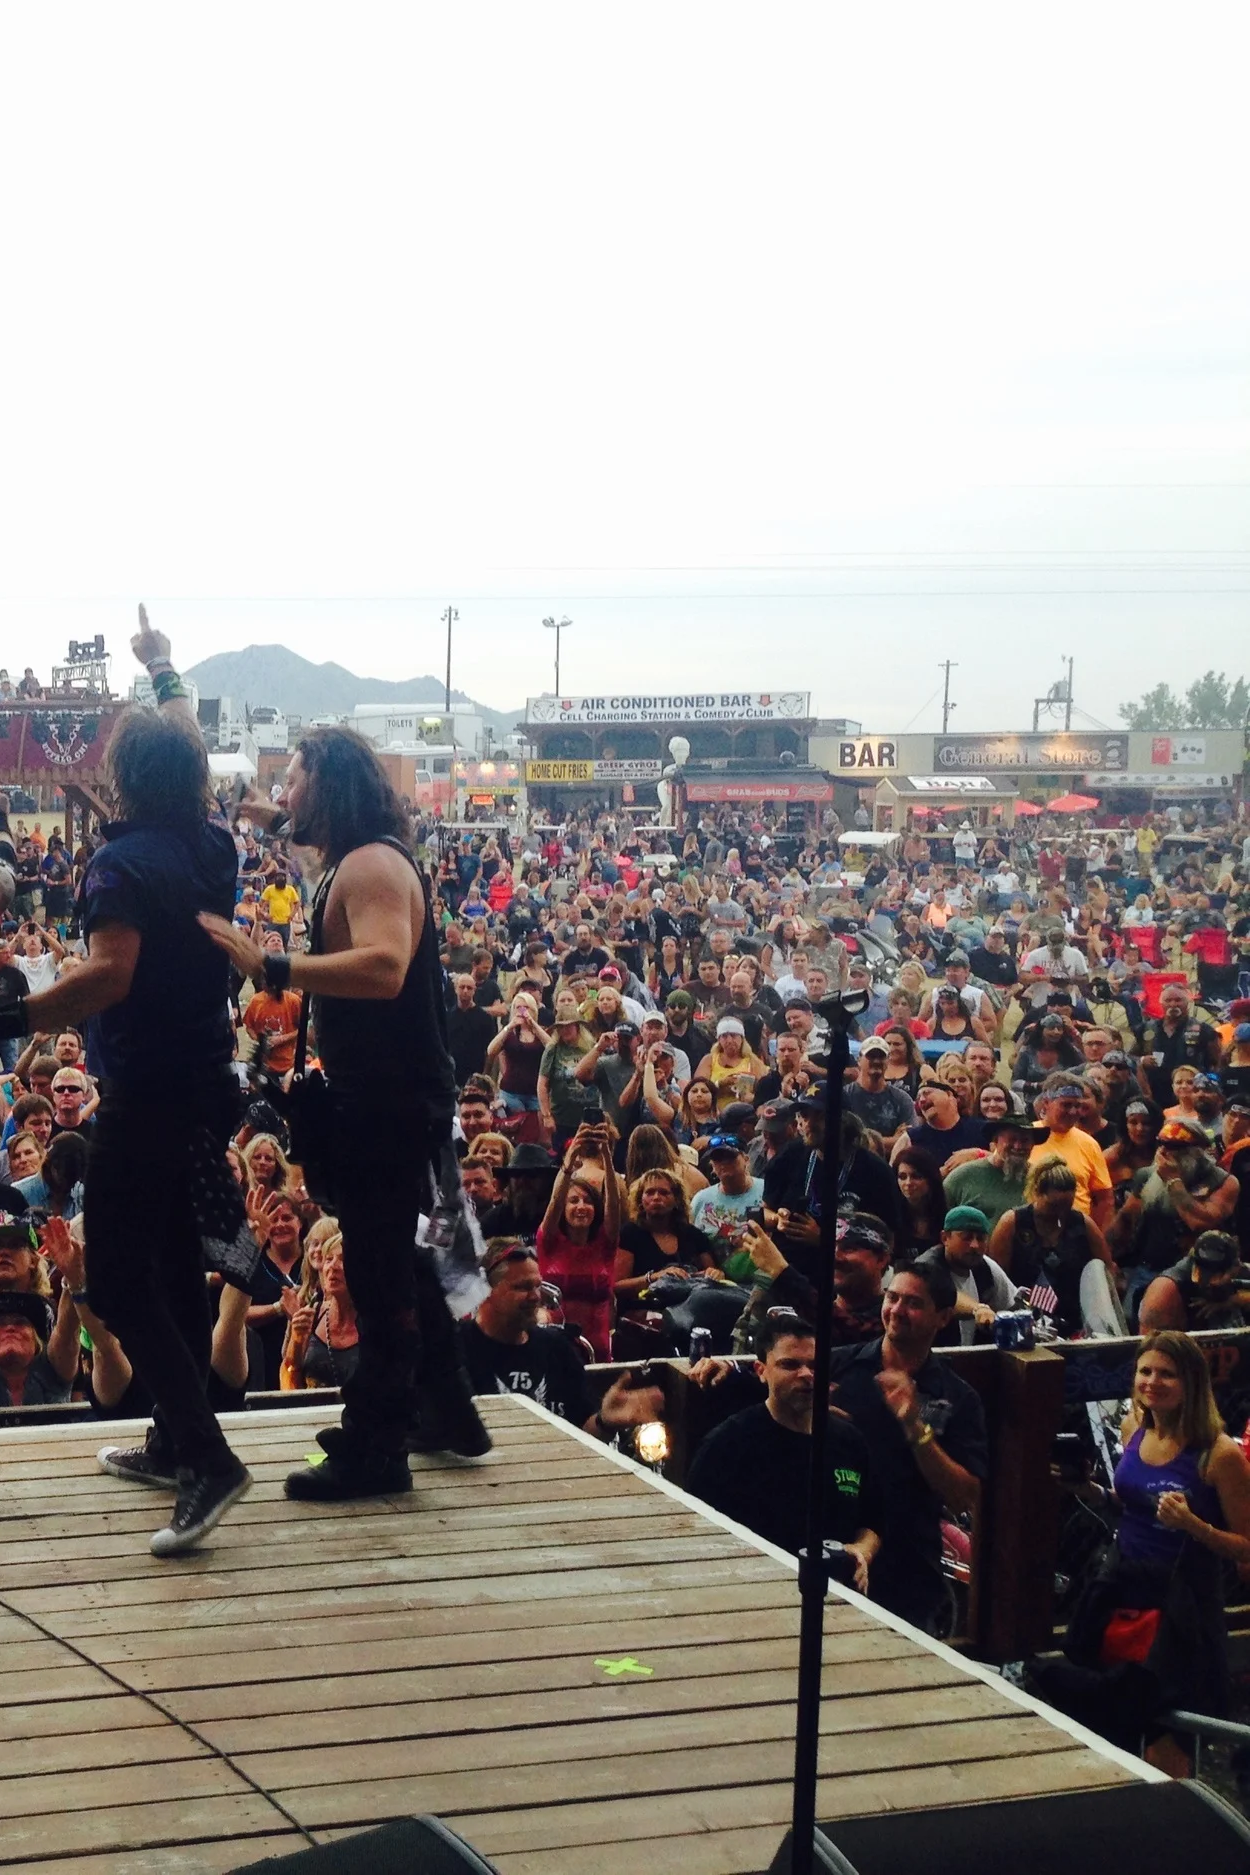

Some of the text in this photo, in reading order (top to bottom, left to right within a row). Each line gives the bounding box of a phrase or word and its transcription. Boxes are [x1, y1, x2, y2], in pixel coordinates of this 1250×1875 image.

[580, 694, 752, 710] AIR CONDITIONED BAR
[560, 712, 582, 722] CELL
[586, 711, 638, 721] CHARGING
[640, 710, 681, 720] STATION
[694, 708, 737, 719] COMEDY
[746, 707, 774, 718] CLUB
[388, 719, 413, 728] TOILETS
[839, 742, 896, 768] BAR
[938, 745, 1103, 768] General Store
[531, 762, 588, 779] HOME CUT FRIES
[597, 760, 658, 769] GREEK GYROS
[508, 1371, 533, 1390] 75
